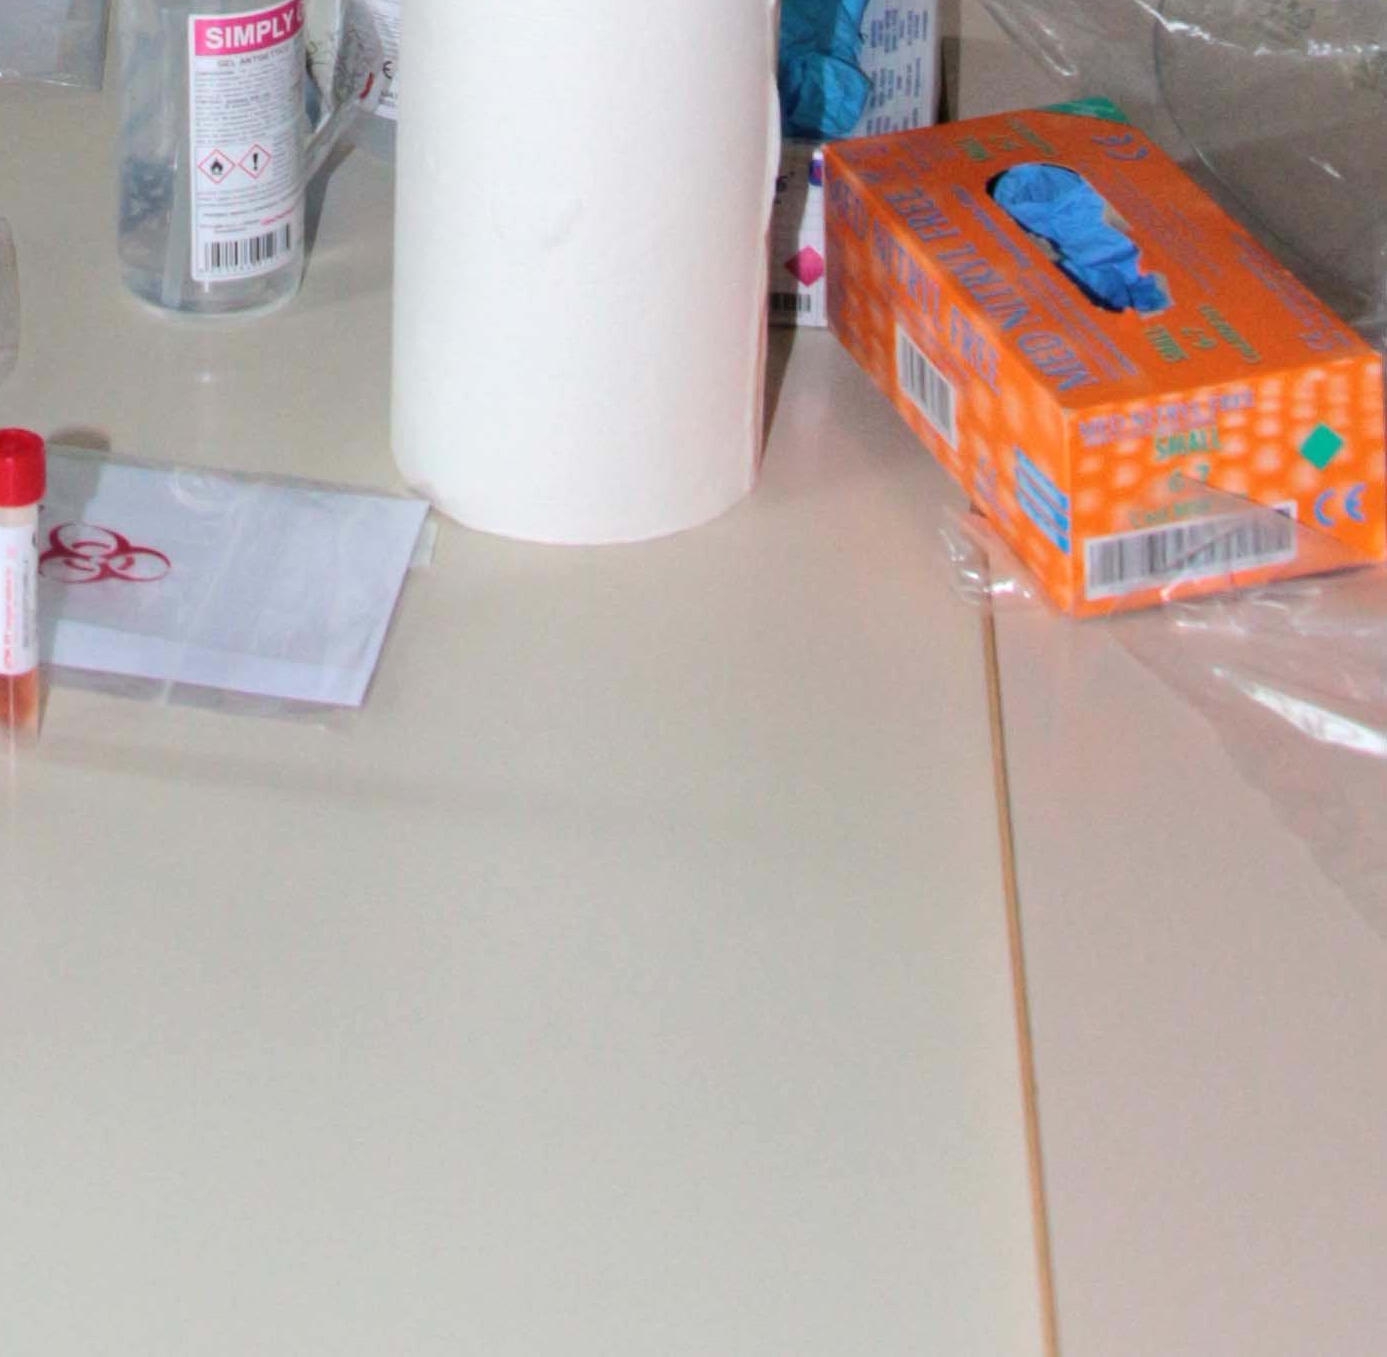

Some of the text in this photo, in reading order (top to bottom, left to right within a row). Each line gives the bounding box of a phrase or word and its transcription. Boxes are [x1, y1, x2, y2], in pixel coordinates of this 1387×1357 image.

[205, 10, 295, 49] SIMPLY
[1017, 330, 1100, 391] MED
[1156, 425, 1221, 460] SMALL
[1312, 483, 1369, 528] CE
